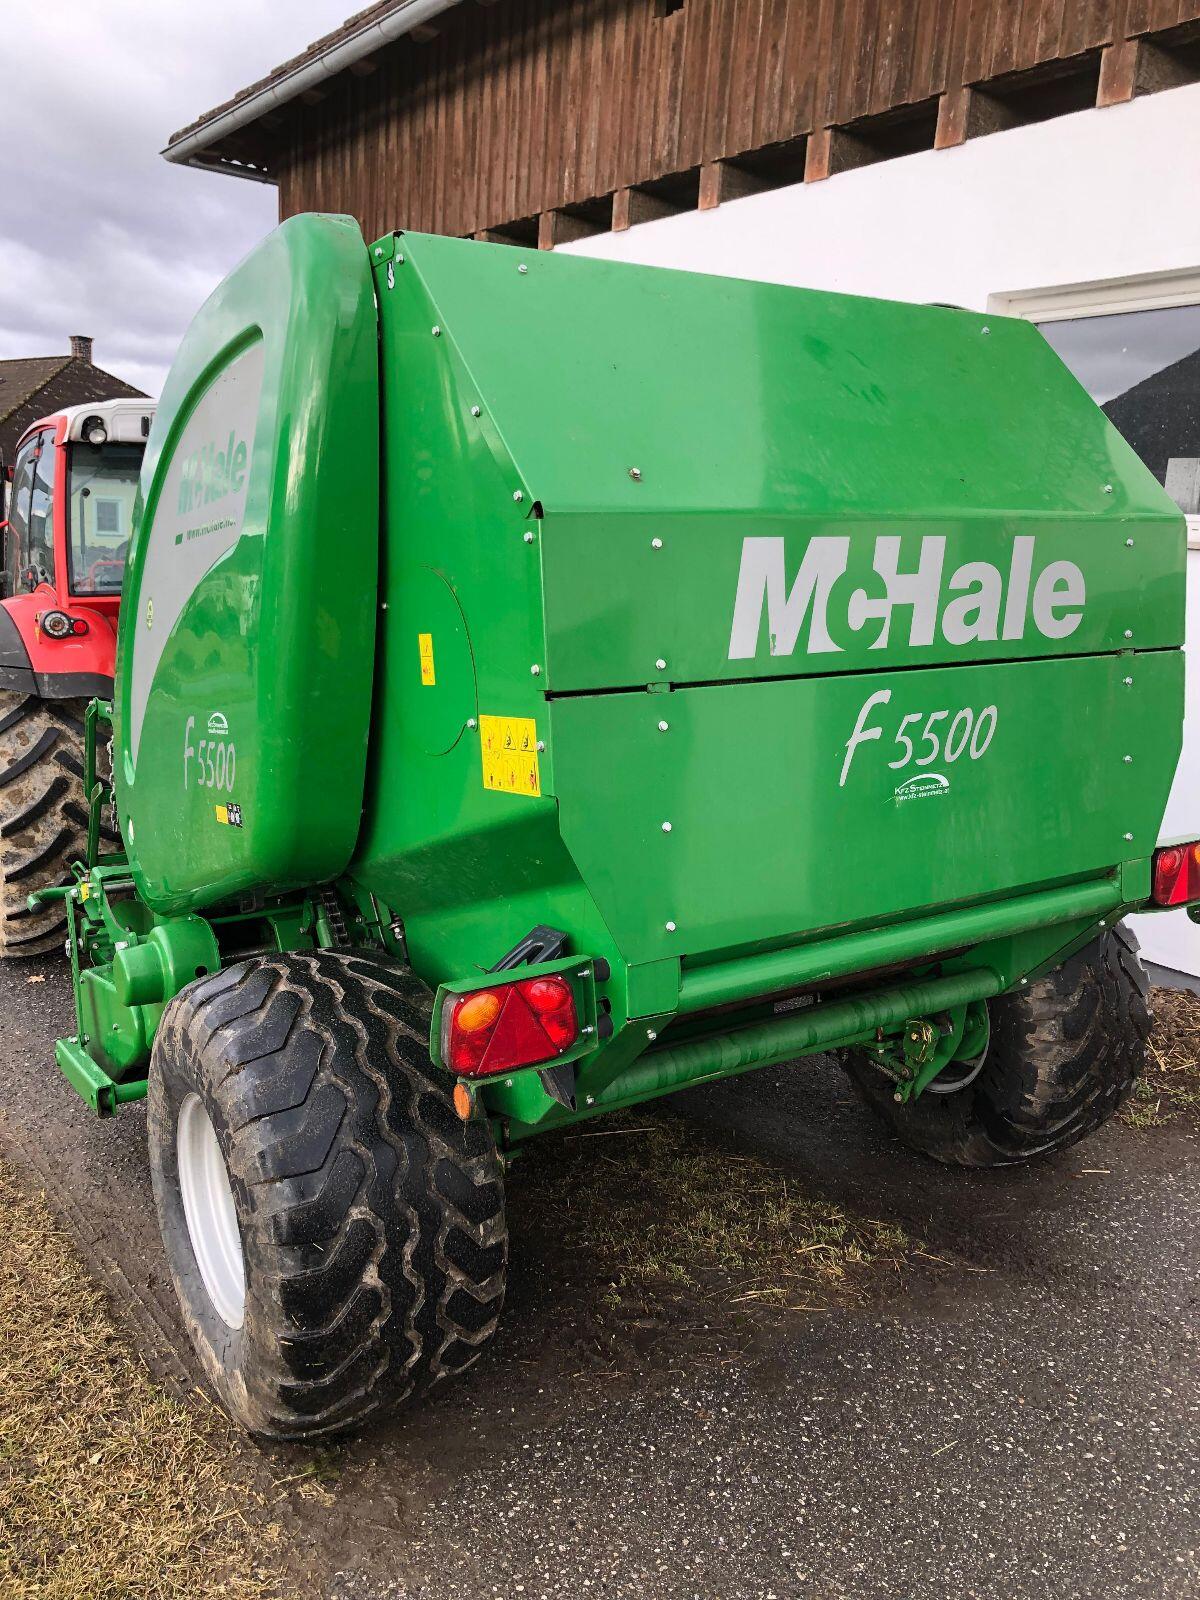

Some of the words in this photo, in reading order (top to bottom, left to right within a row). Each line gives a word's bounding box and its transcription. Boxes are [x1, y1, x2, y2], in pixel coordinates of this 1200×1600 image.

[727, 535, 1086, 660] McHale
[197, 739, 236, 793] 5500
[888, 704, 998, 769] 5500
